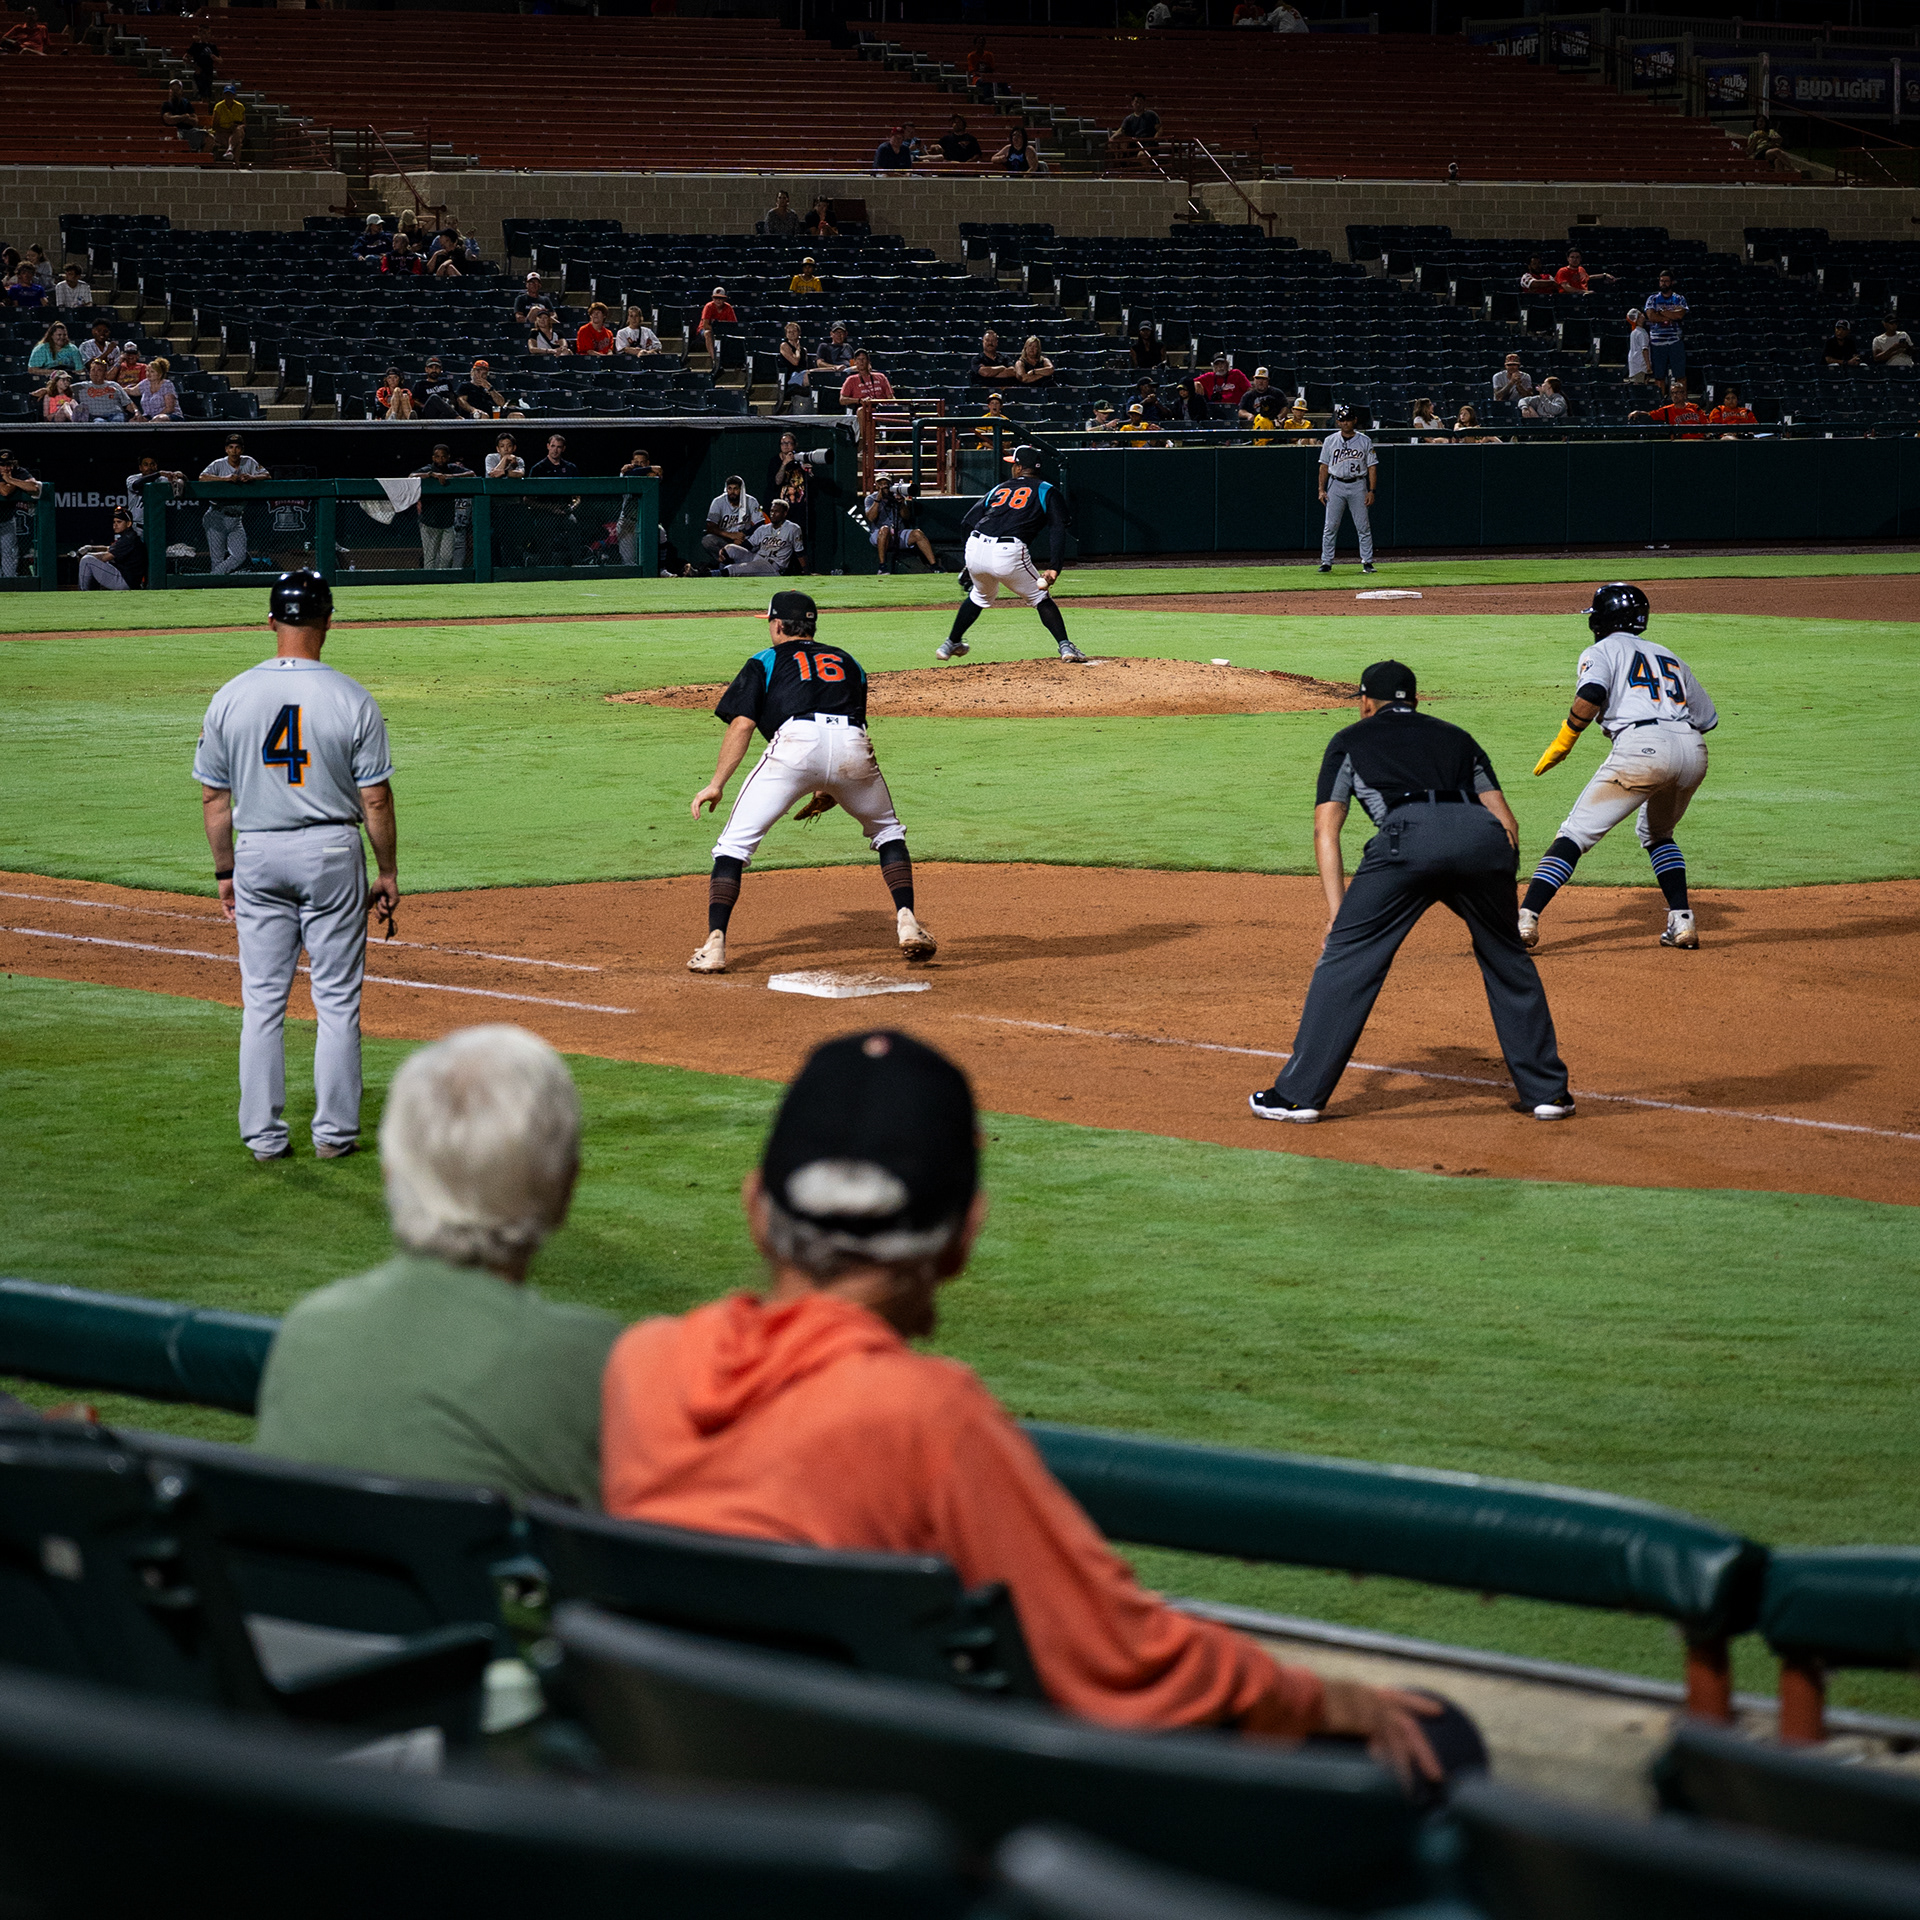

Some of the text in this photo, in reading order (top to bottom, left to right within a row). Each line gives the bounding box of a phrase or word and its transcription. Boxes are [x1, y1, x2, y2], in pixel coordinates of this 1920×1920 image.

[1798, 79, 1883, 100] BUD LIGHT
[1350, 463, 1361, 474] 24
[55, 491, 128, 508] MiLB.co
[990, 487, 1033, 510] 38
[793, 650, 846, 683] 16
[1628, 650, 1688, 707] 45
[262, 704, 311, 788] 4
